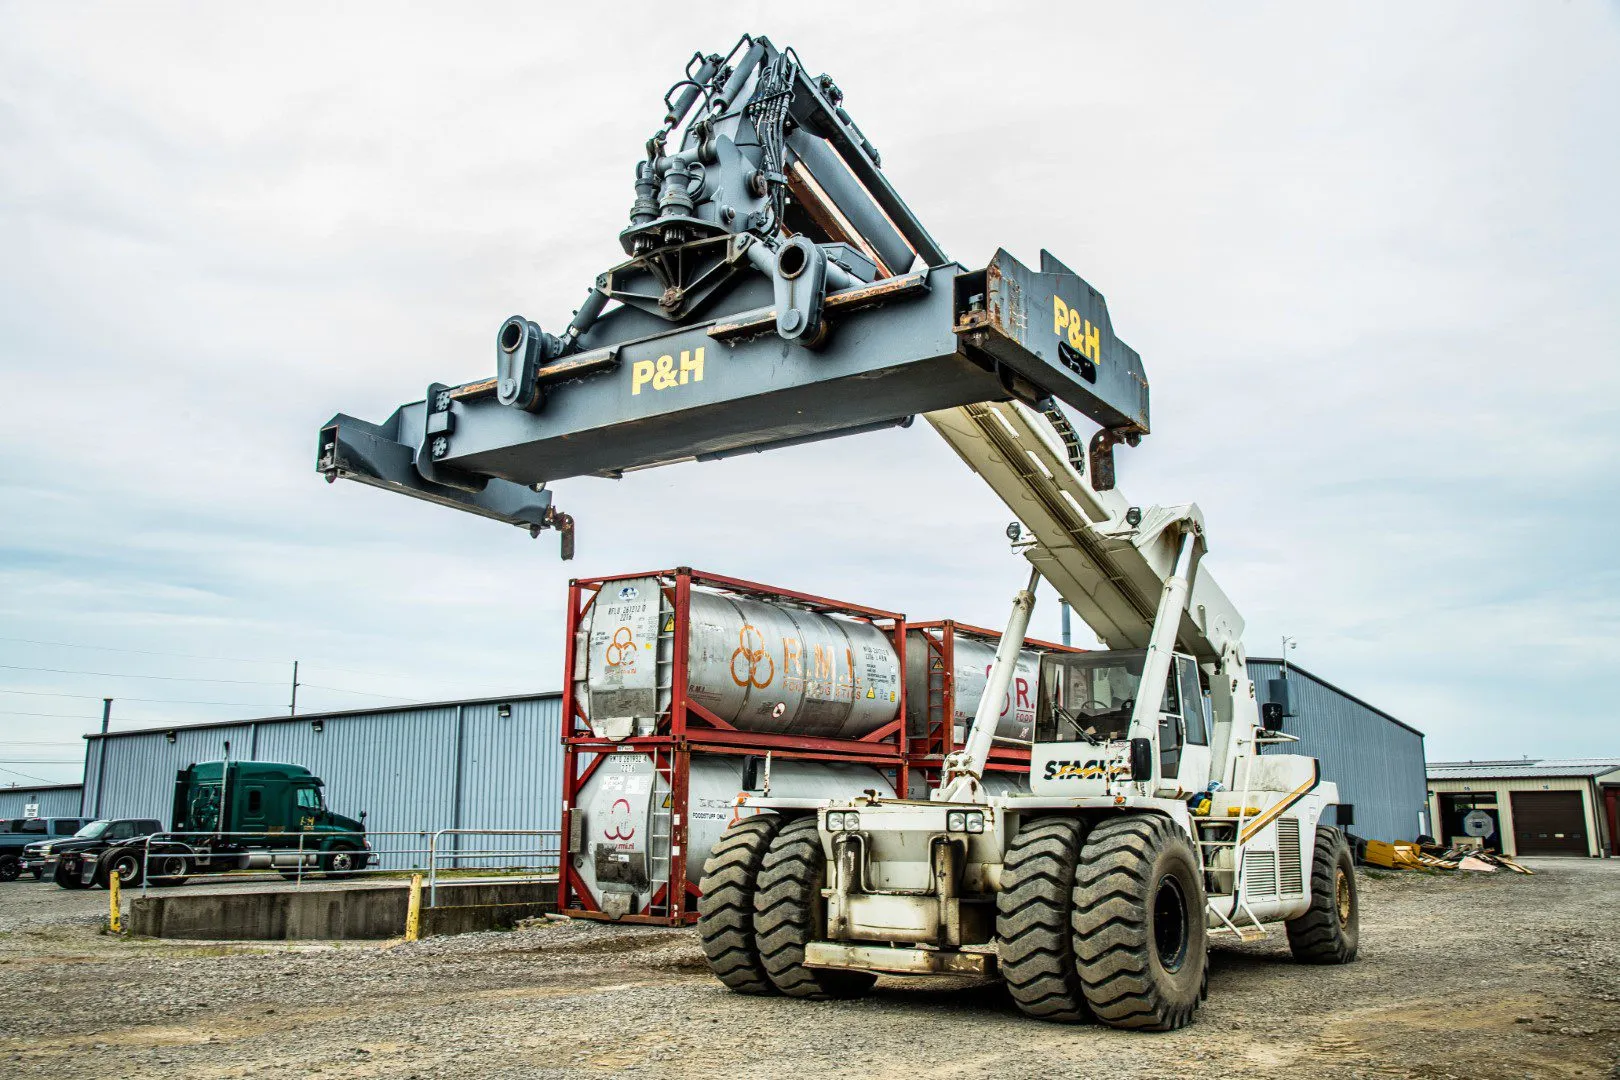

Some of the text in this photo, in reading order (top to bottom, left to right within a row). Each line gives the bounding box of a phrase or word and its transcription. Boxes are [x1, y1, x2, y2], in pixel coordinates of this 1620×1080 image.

[1053, 294, 1100, 366] P&H
[632, 346, 705, 396] P&H
[1016, 713, 1034, 722] FOOD
[1043, 759, 1123, 780] STACK
[692, 812, 716, 820] FOODSTUFF
